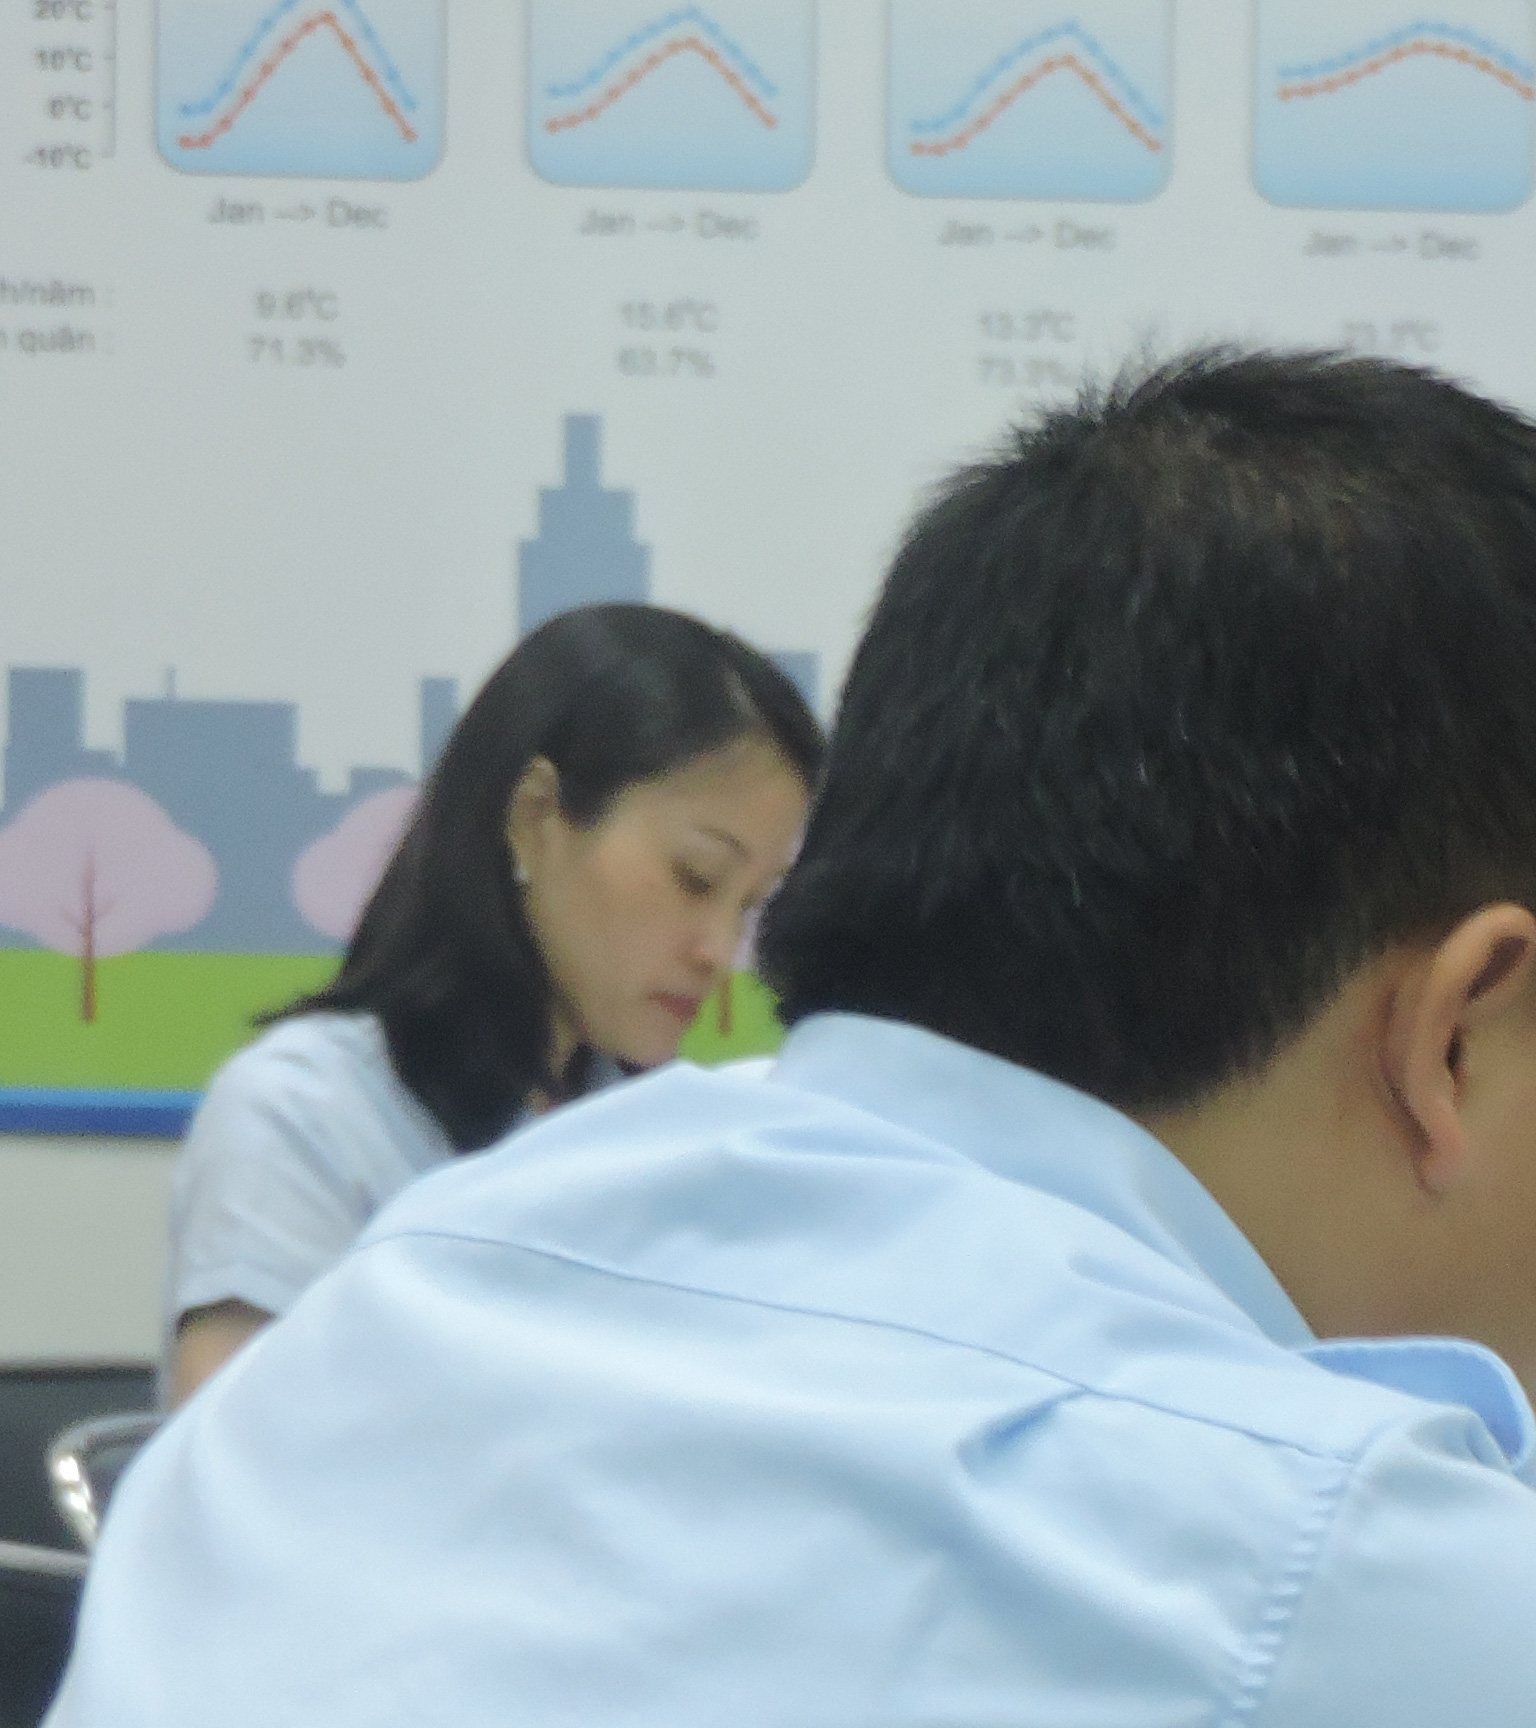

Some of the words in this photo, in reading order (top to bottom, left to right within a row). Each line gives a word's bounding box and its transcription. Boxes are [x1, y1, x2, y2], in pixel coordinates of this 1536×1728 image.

[207, 198, 265, 225] Jan
[327, 200, 389, 229] Dec
[578, 207, 637, 236] Jan
[696, 207, 760, 240] Dec
[938, 220, 995, 247] Jan
[1055, 221, 1115, 250] Dec
[1304, 230, 1358, 257] Jan
[1419, 230, 1480, 260] Dec
